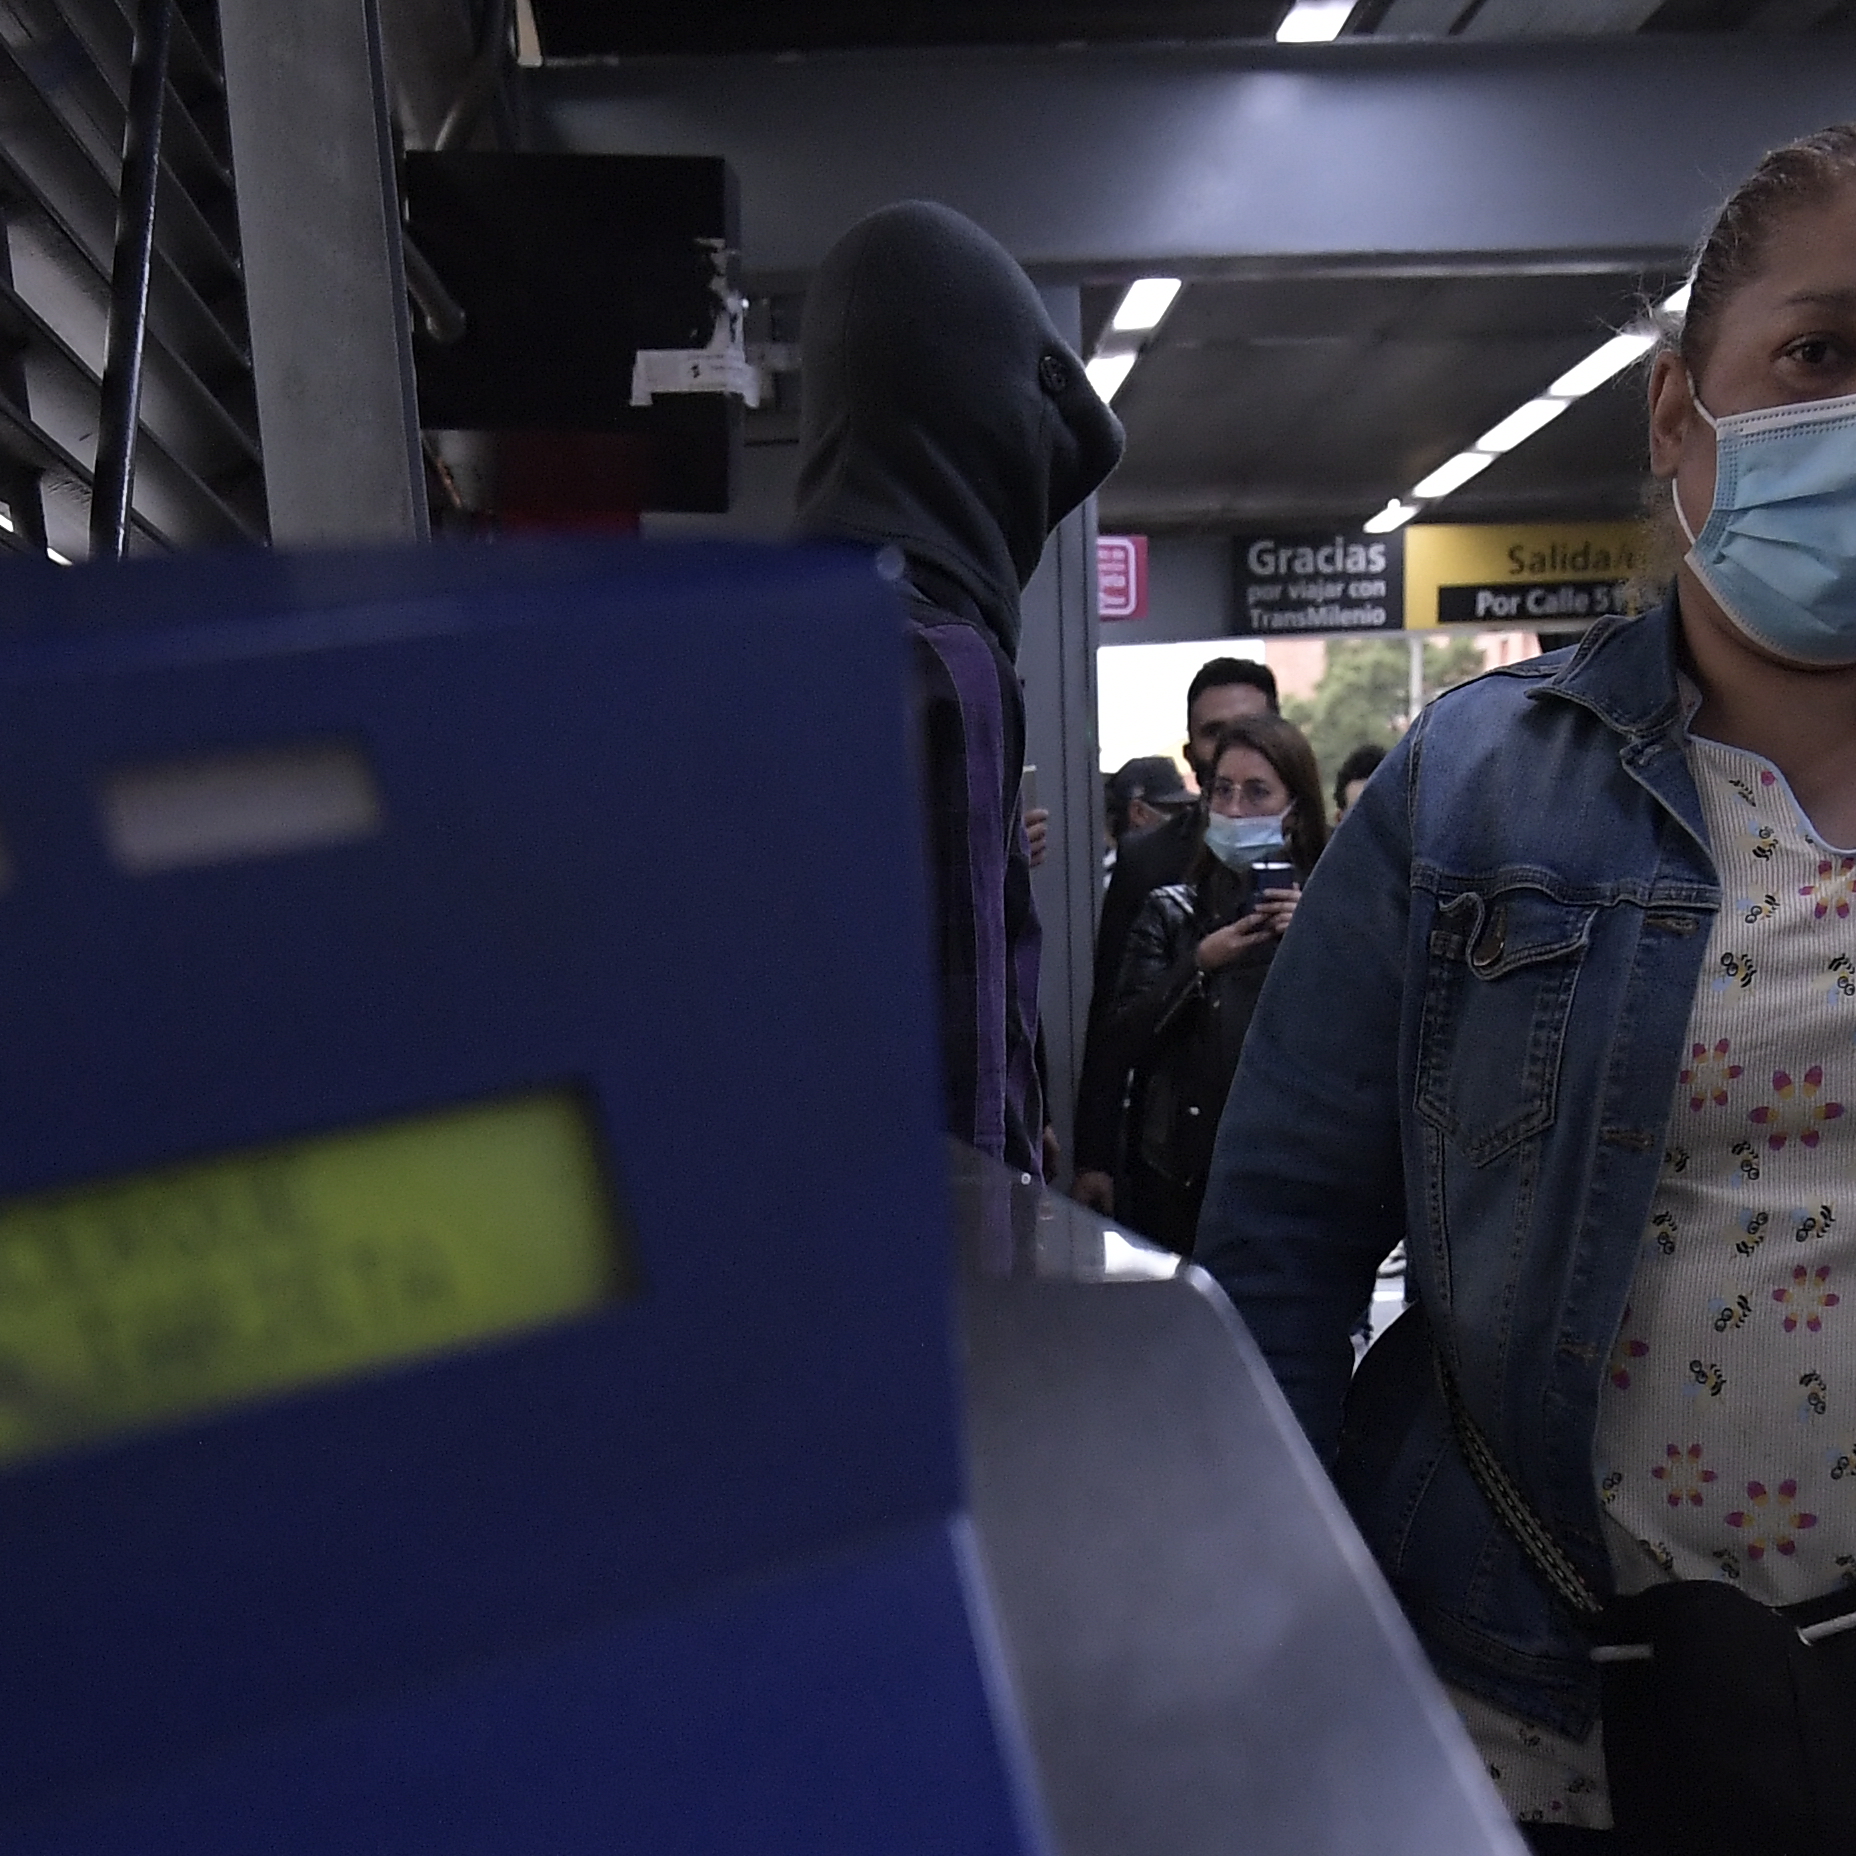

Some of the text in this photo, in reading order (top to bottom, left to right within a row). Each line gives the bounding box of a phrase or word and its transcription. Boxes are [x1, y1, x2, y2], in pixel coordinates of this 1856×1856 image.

[1248, 535, 1387, 576] Gracias
[1248, 578, 1387, 604] por viajar con
[1475, 589, 1521, 617] Por
[1527, 587, 1589, 615] Calle
[1249, 603, 1387, 628] TransMilenio
